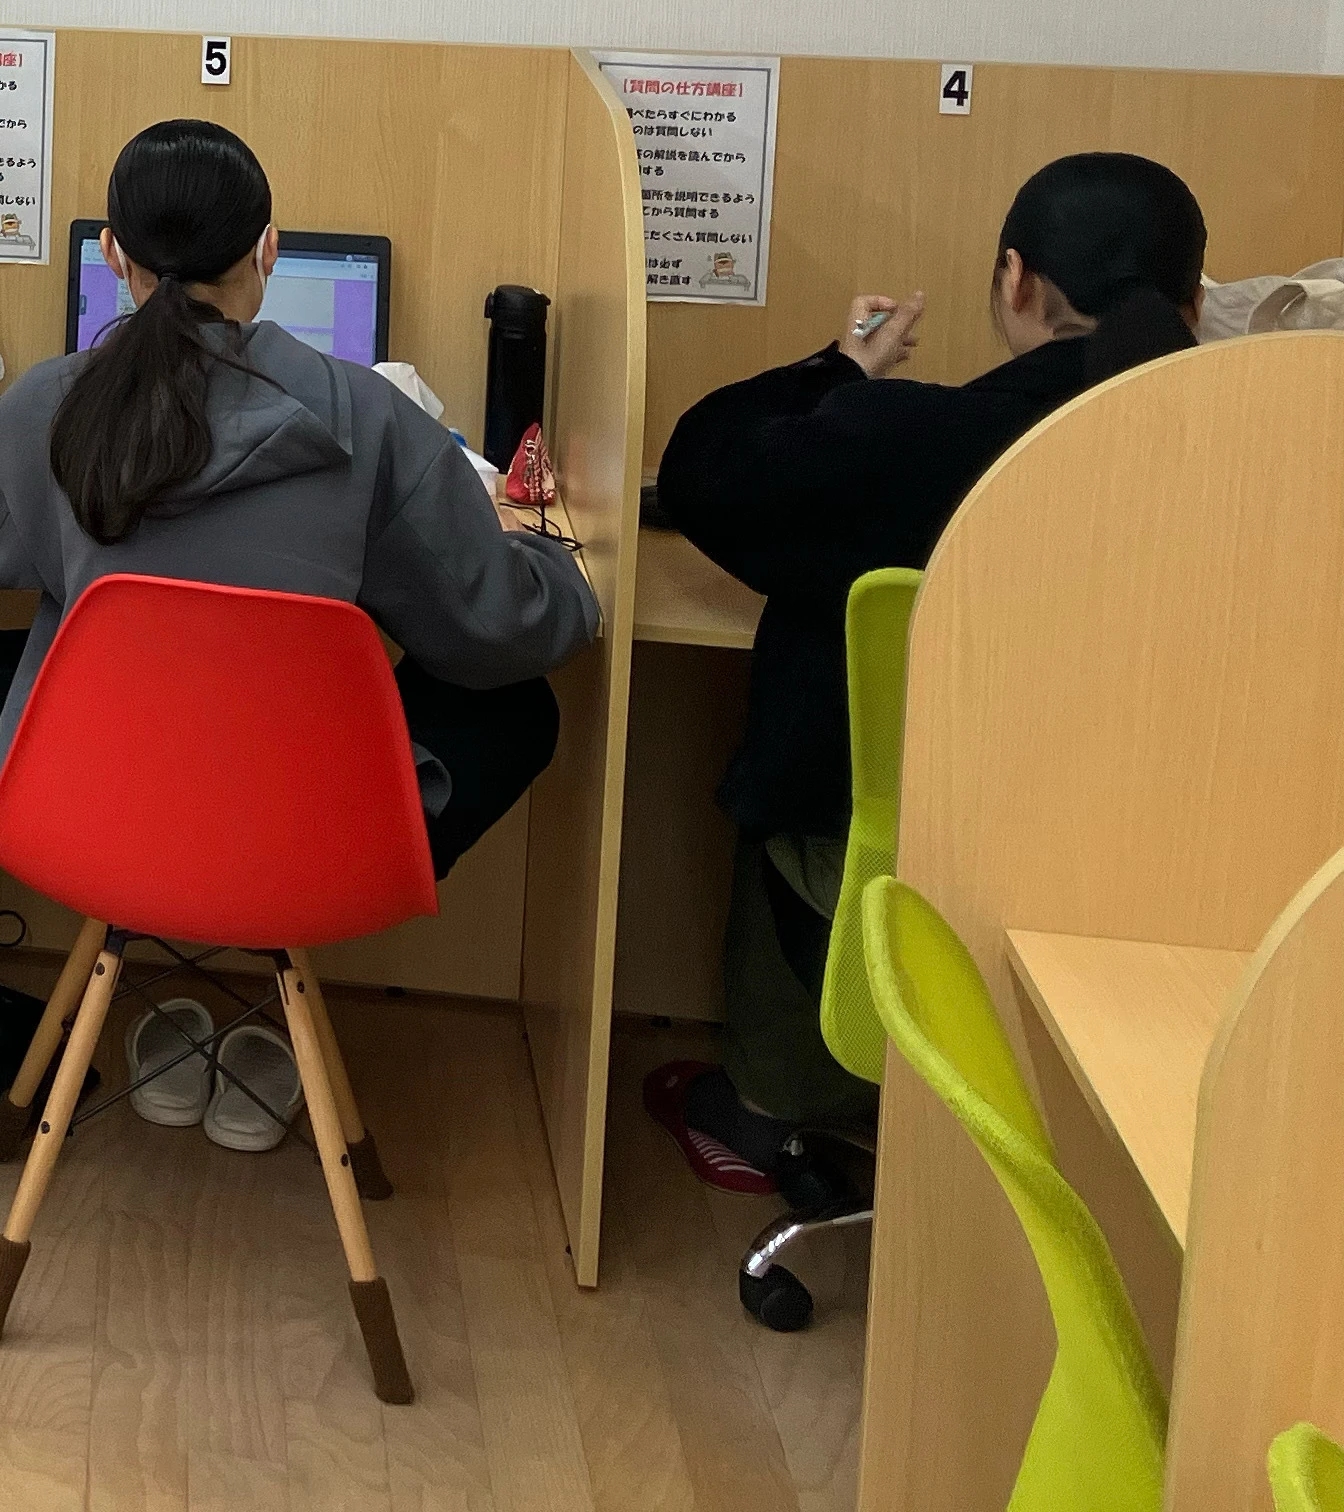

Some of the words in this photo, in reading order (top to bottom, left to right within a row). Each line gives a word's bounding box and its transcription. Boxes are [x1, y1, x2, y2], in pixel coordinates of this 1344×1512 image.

[205, 41, 227, 76] 5
[943, 71, 968, 106] 4
[633, 125, 712, 138] のは質問しない
[638, 165, 664, 176] する
[645, 257, 683, 269] は必ず
